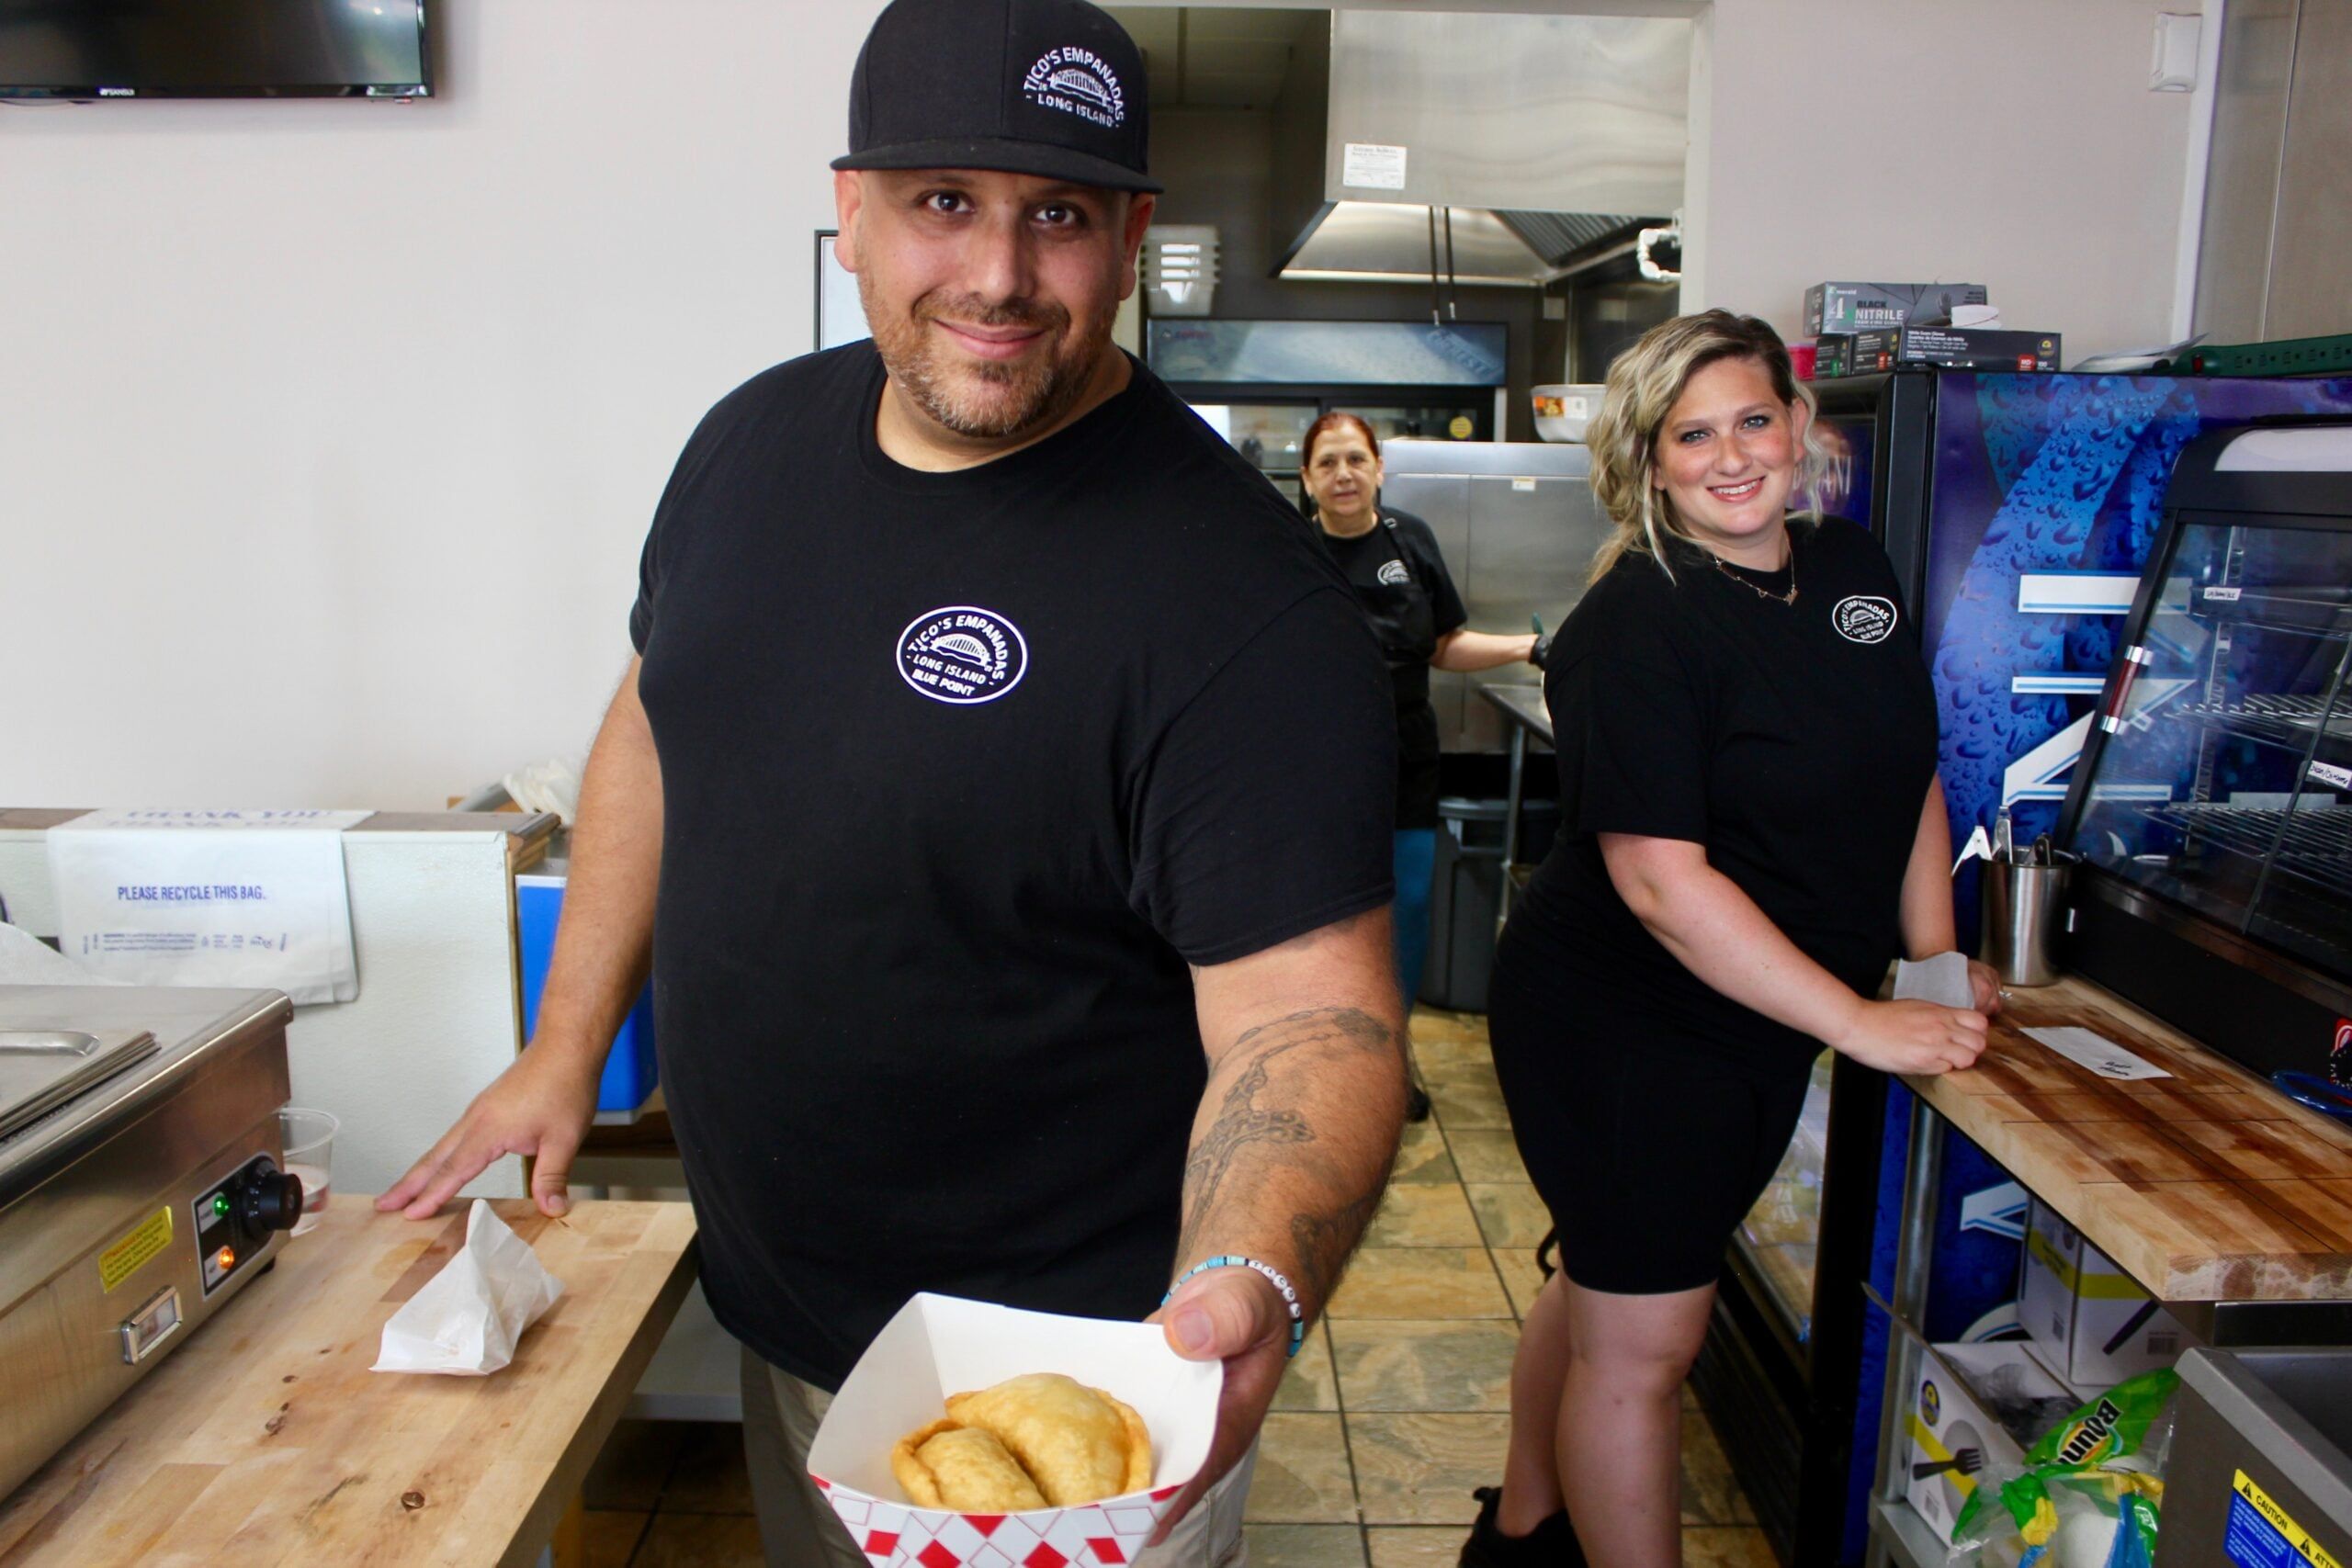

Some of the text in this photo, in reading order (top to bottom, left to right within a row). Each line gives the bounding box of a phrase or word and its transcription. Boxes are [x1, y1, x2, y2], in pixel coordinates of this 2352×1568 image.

[1023, 47, 1124, 120] TICO'S EMPANADAS
[1037, 94, 1073, 112] LONG
[1076, 104, 1115, 128] ISLAND
[1855, 309, 1905, 321] NITRILE
[1857, 300, 1888, 309] BLACK
[908, 615, 1008, 680] TICO'S EMPANADAS
[911, 669, 976, 697] BLUE POINT
[913, 654, 987, 685] LONG ISLAND
[118, 886, 267, 901] PLEASE RECYCLE THIS BAG.
[2256, 1495, 2288, 1530] CAUTION
